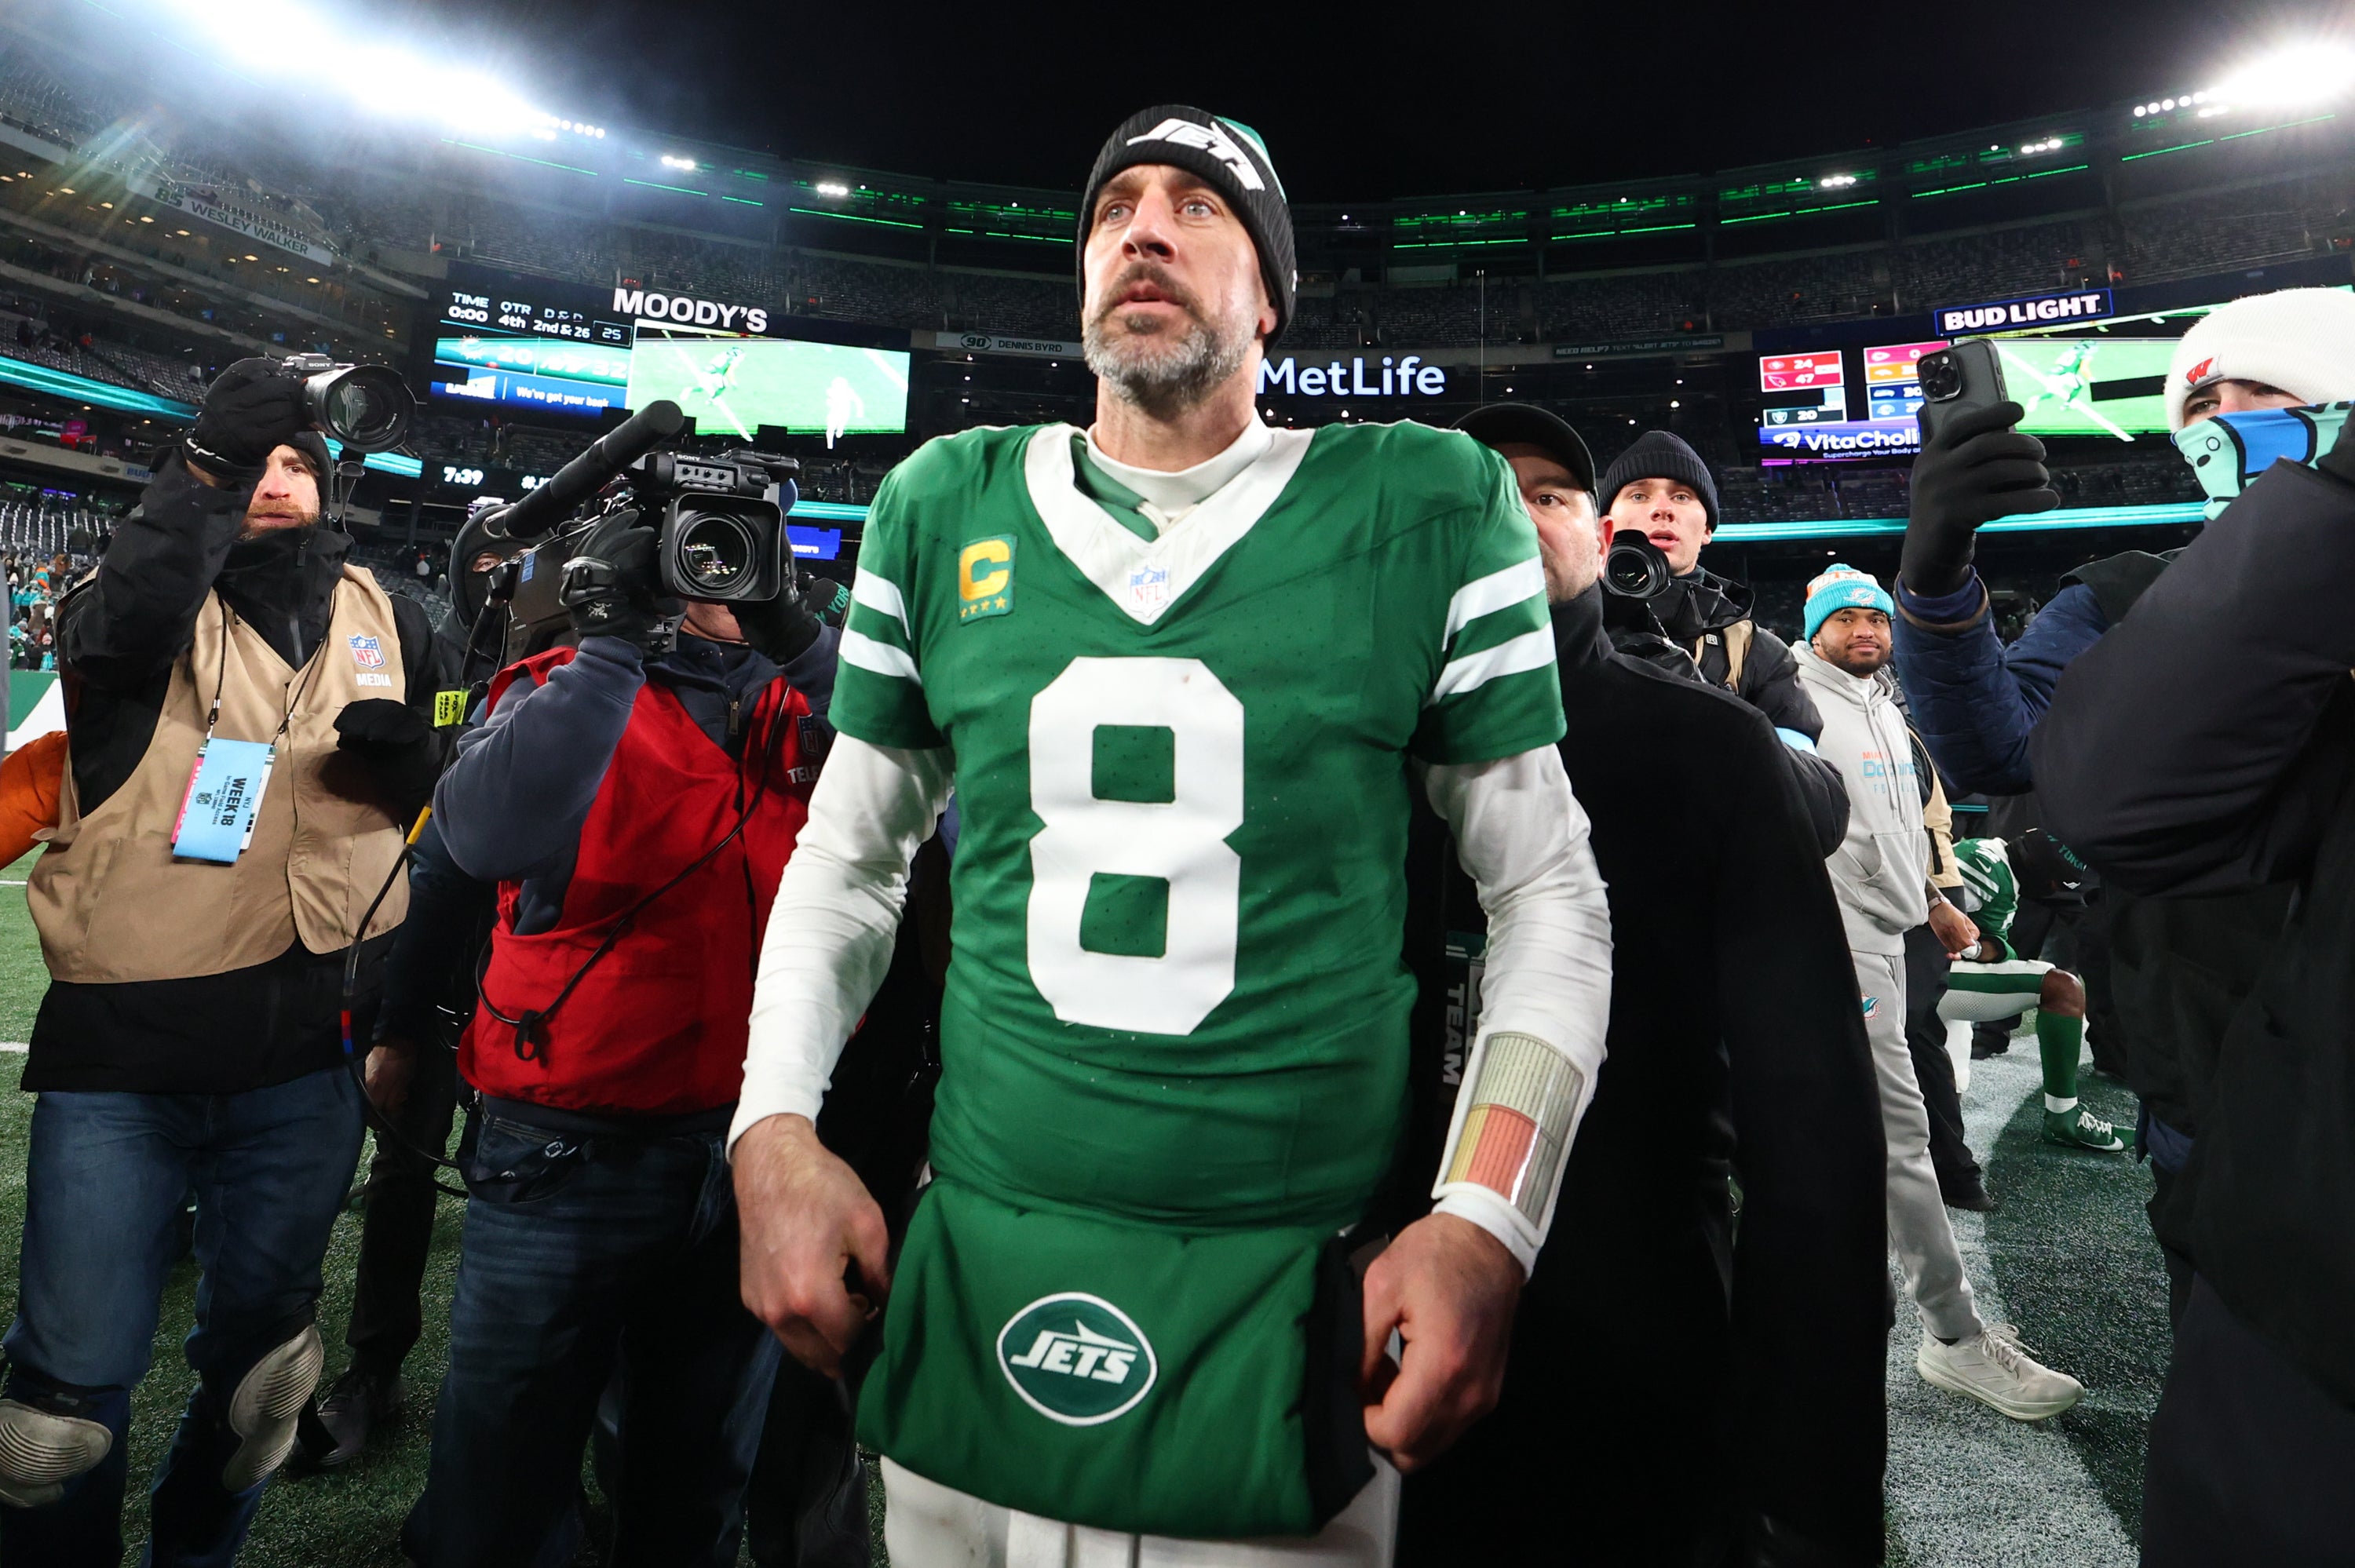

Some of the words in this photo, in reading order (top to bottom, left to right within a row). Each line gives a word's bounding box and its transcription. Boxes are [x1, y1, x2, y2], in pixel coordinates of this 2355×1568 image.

[192, 201, 251, 232] WESLEY
[254, 224, 308, 254] WALKER
[452, 292, 489, 308] TIME
[501, 301, 531, 315] QTR
[612, 288, 768, 333] MOODY'S
[1944, 307, 2006, 331] BUD
[2010, 294, 2101, 323] LIGHT
[448, 306, 488, 323] 0:00
[498, 314, 526, 328] 4th
[533, 319, 558, 334] 2nd
[560, 326, 572, 337] &
[574, 326, 590, 338] 26
[966, 337, 986, 348] 90
[999, 341, 1033, 350] DENNIS
[1035, 344, 1062, 352] BYRD
[1909, 348, 1921, 359] 0
[497, 346, 534, 365] 20
[1794, 359, 1813, 370] 24
[592, 359, 627, 379] 32
[1256, 356, 1445, 396] MetLife
[2186, 357, 2213, 385] W
[1795, 374, 1815, 384] 47
[517, 386, 546, 399] We've
[546, 392, 563, 403] got
[563, 395, 585, 405] your
[1797, 410, 1817, 421] 20
[1805, 428, 1919, 450] VitaCholi
[1823, 450, 1871, 459] Supercharge
[1891, 447, 1911, 456] Body
[444, 466, 484, 486] 7:39
[958, 539, 1010, 602] C
[1135, 585, 1162, 603] NFL
[355, 649, 381, 665] NFL
[356, 673, 392, 687] MEDIA
[218, 795, 227, 808] Field
[226, 778, 247, 812] WEEK
[243, 797, 251, 808] NYJ
[212, 808, 221, 825] Access
[221, 815, 236, 826] 18
[1026, 656, 1244, 1036] 8
[1443, 983, 1465, 1086] TEAM
[1010, 1318, 1137, 1384] JETS
